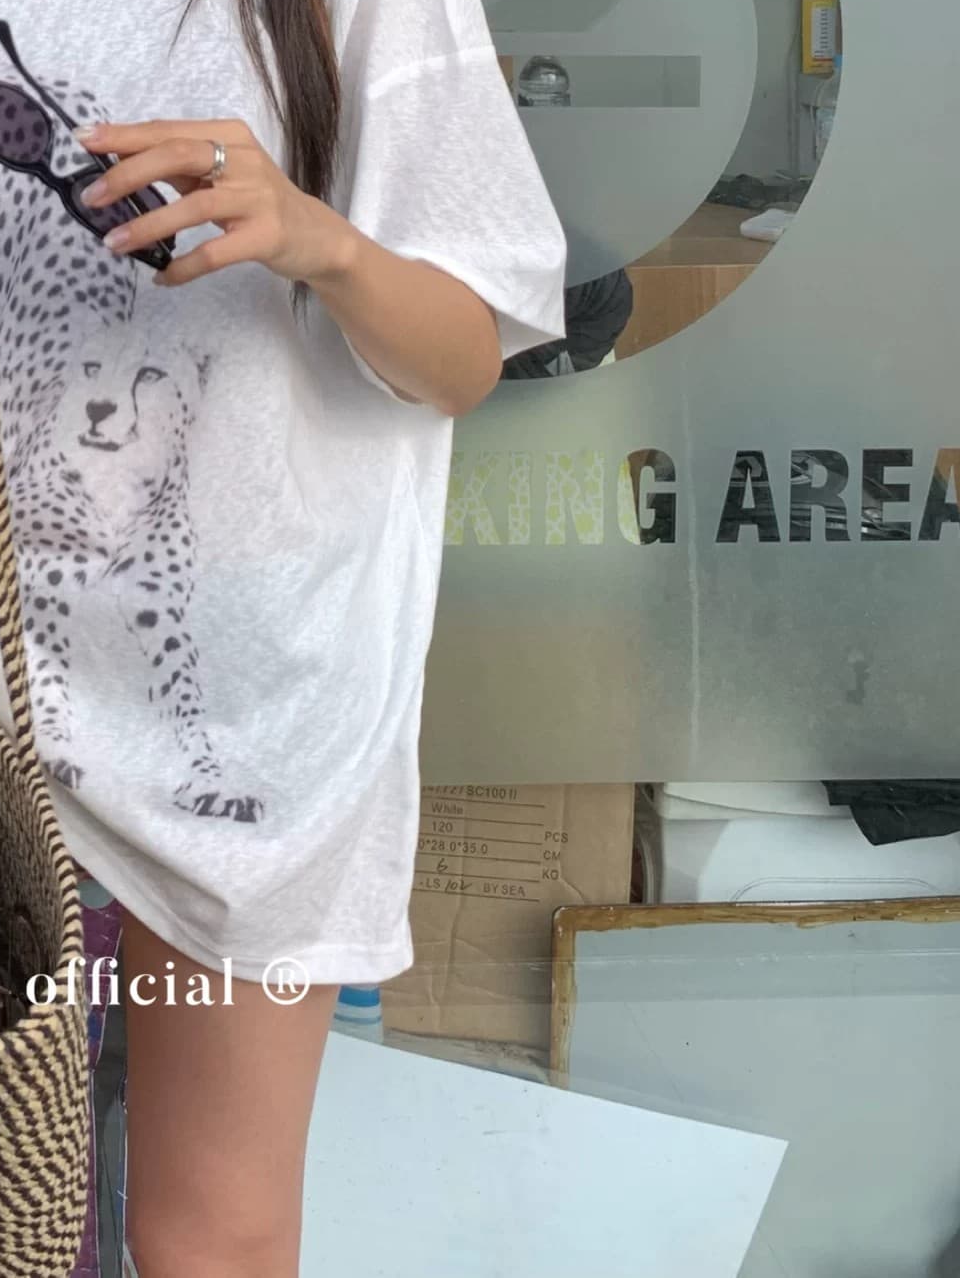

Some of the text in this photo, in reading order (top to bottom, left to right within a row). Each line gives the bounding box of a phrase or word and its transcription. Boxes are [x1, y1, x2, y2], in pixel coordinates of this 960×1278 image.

[443, 448, 960, 545] KING AREA
[432, 821, 569, 844] 120 PCS
[543, 850, 561, 861] CM
[483, 883, 499, 894] BY
[501, 884, 526, 897] SEA
